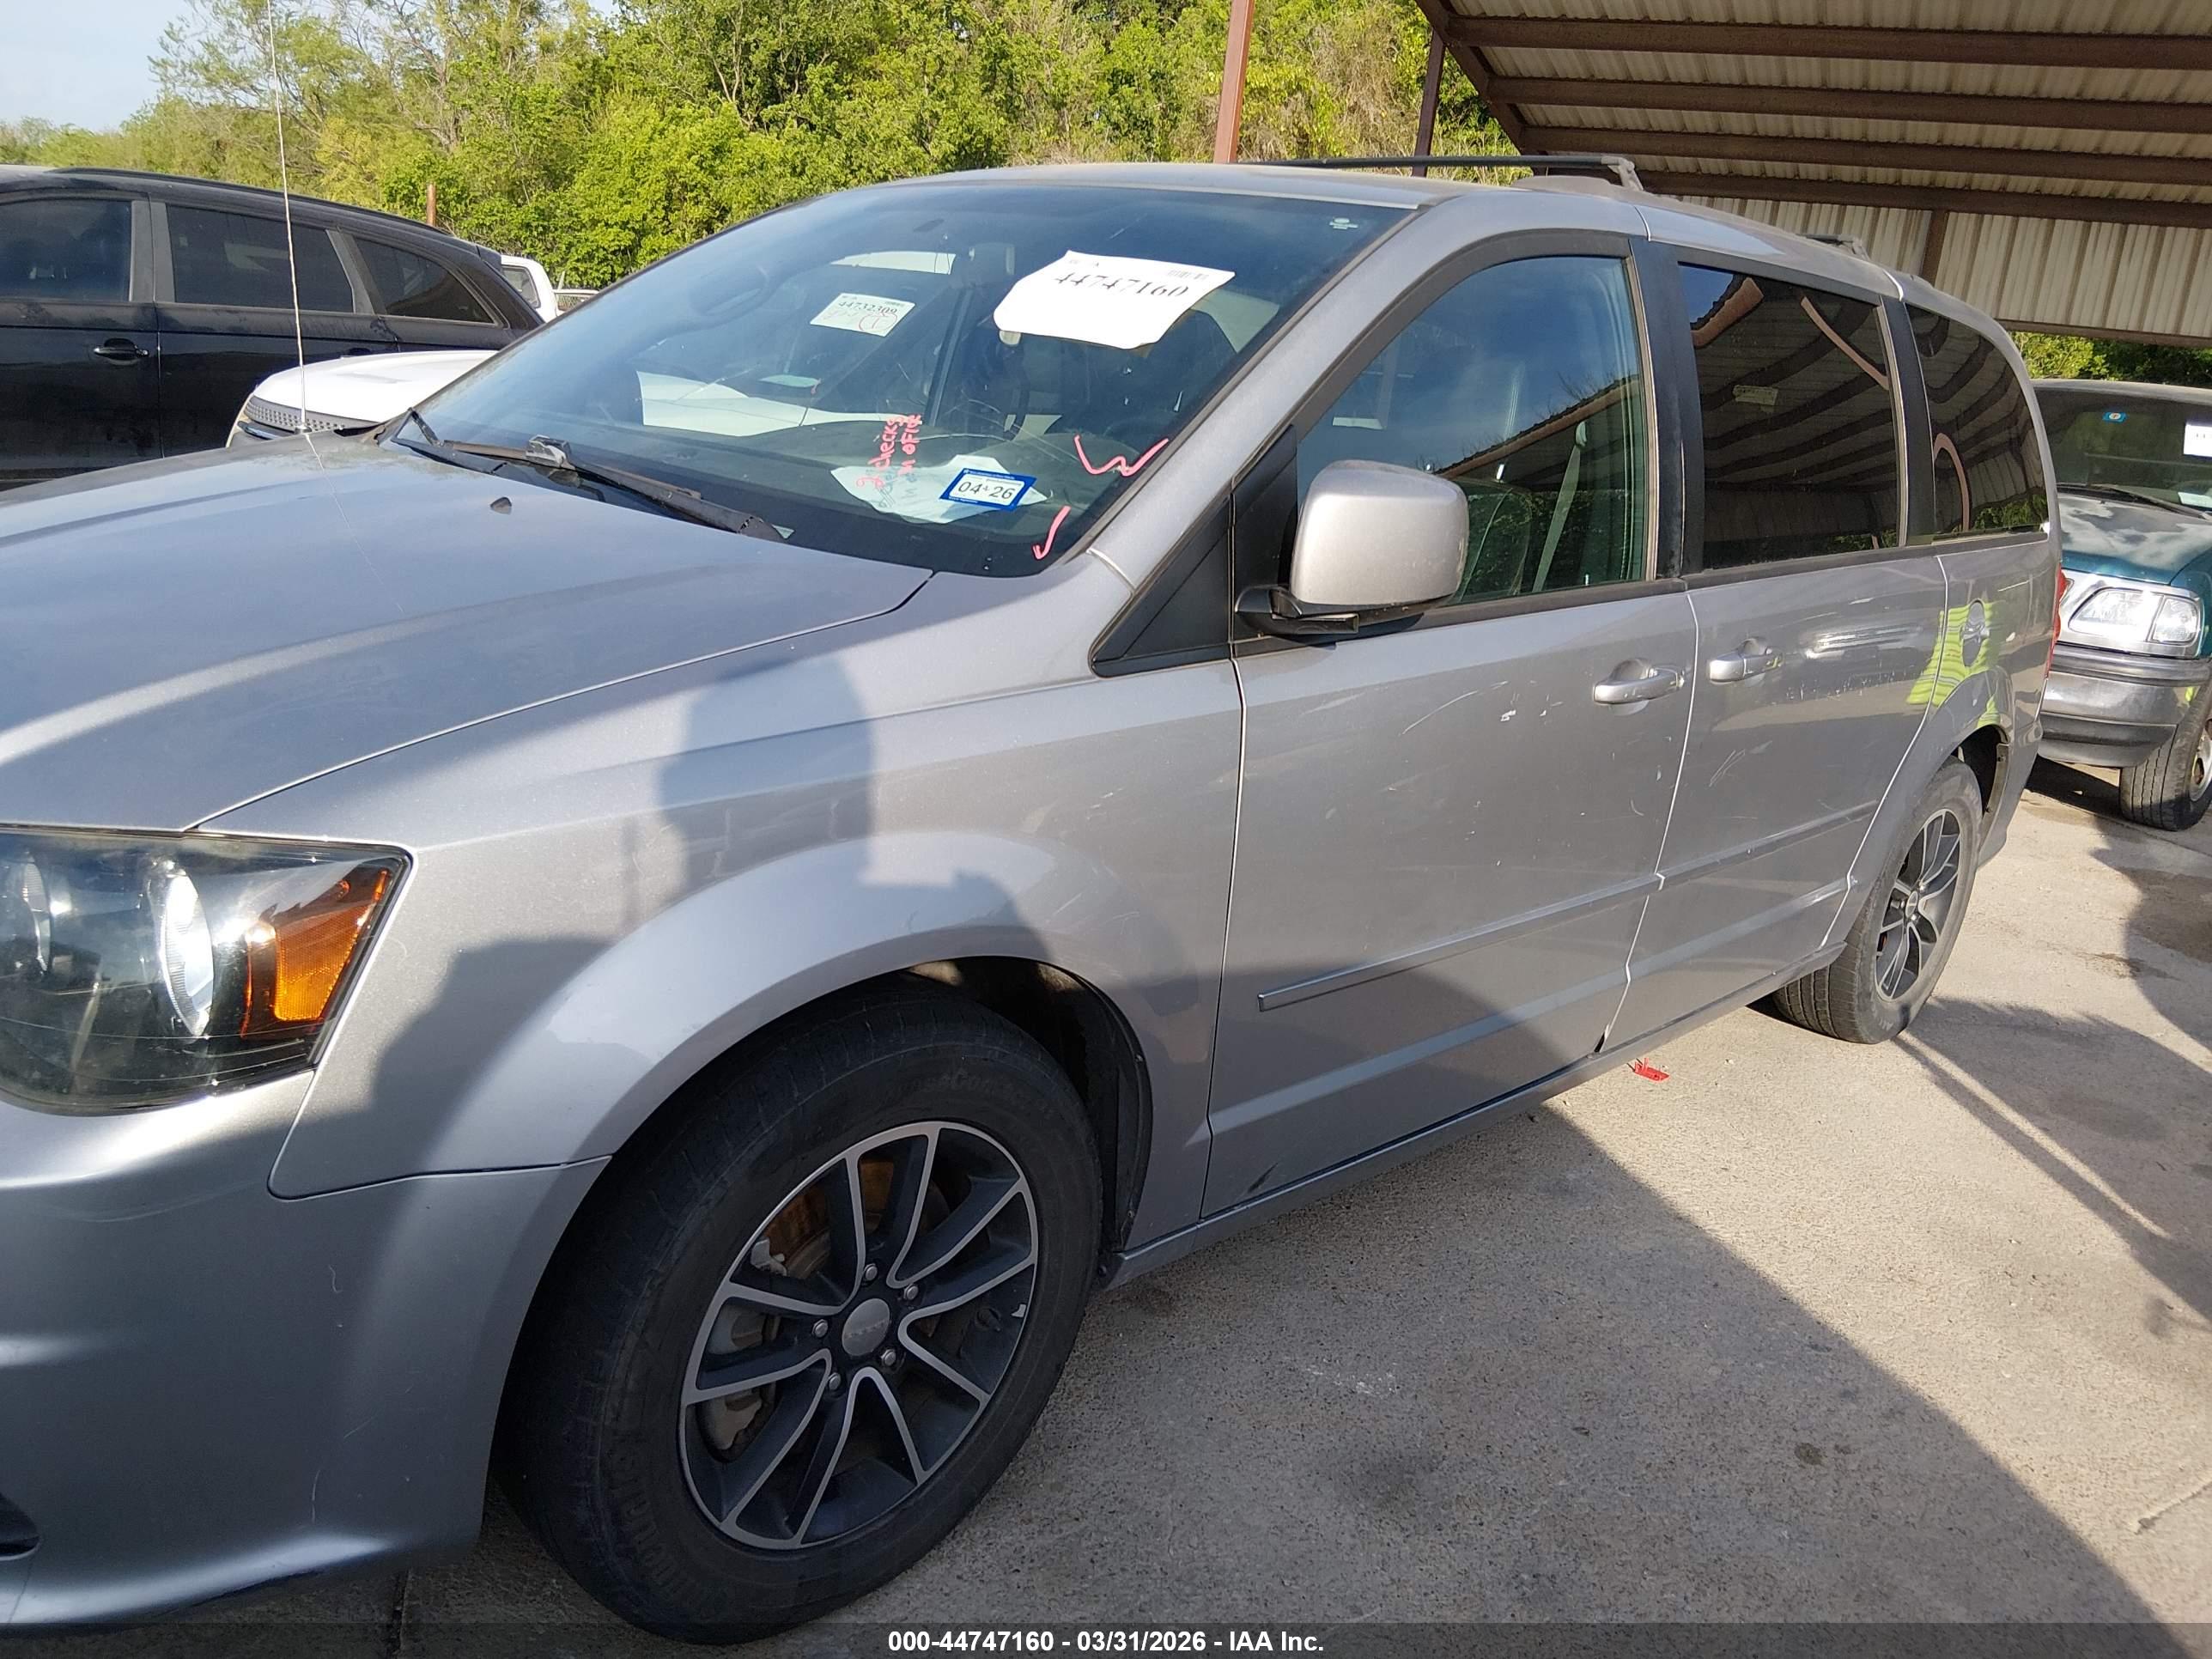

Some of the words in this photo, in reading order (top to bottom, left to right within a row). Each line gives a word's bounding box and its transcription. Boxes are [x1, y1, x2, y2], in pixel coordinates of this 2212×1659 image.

[1054, 271, 1189, 296] 44747160
[957, 481, 983, 495] 04
[989, 485, 1016, 500] 26
